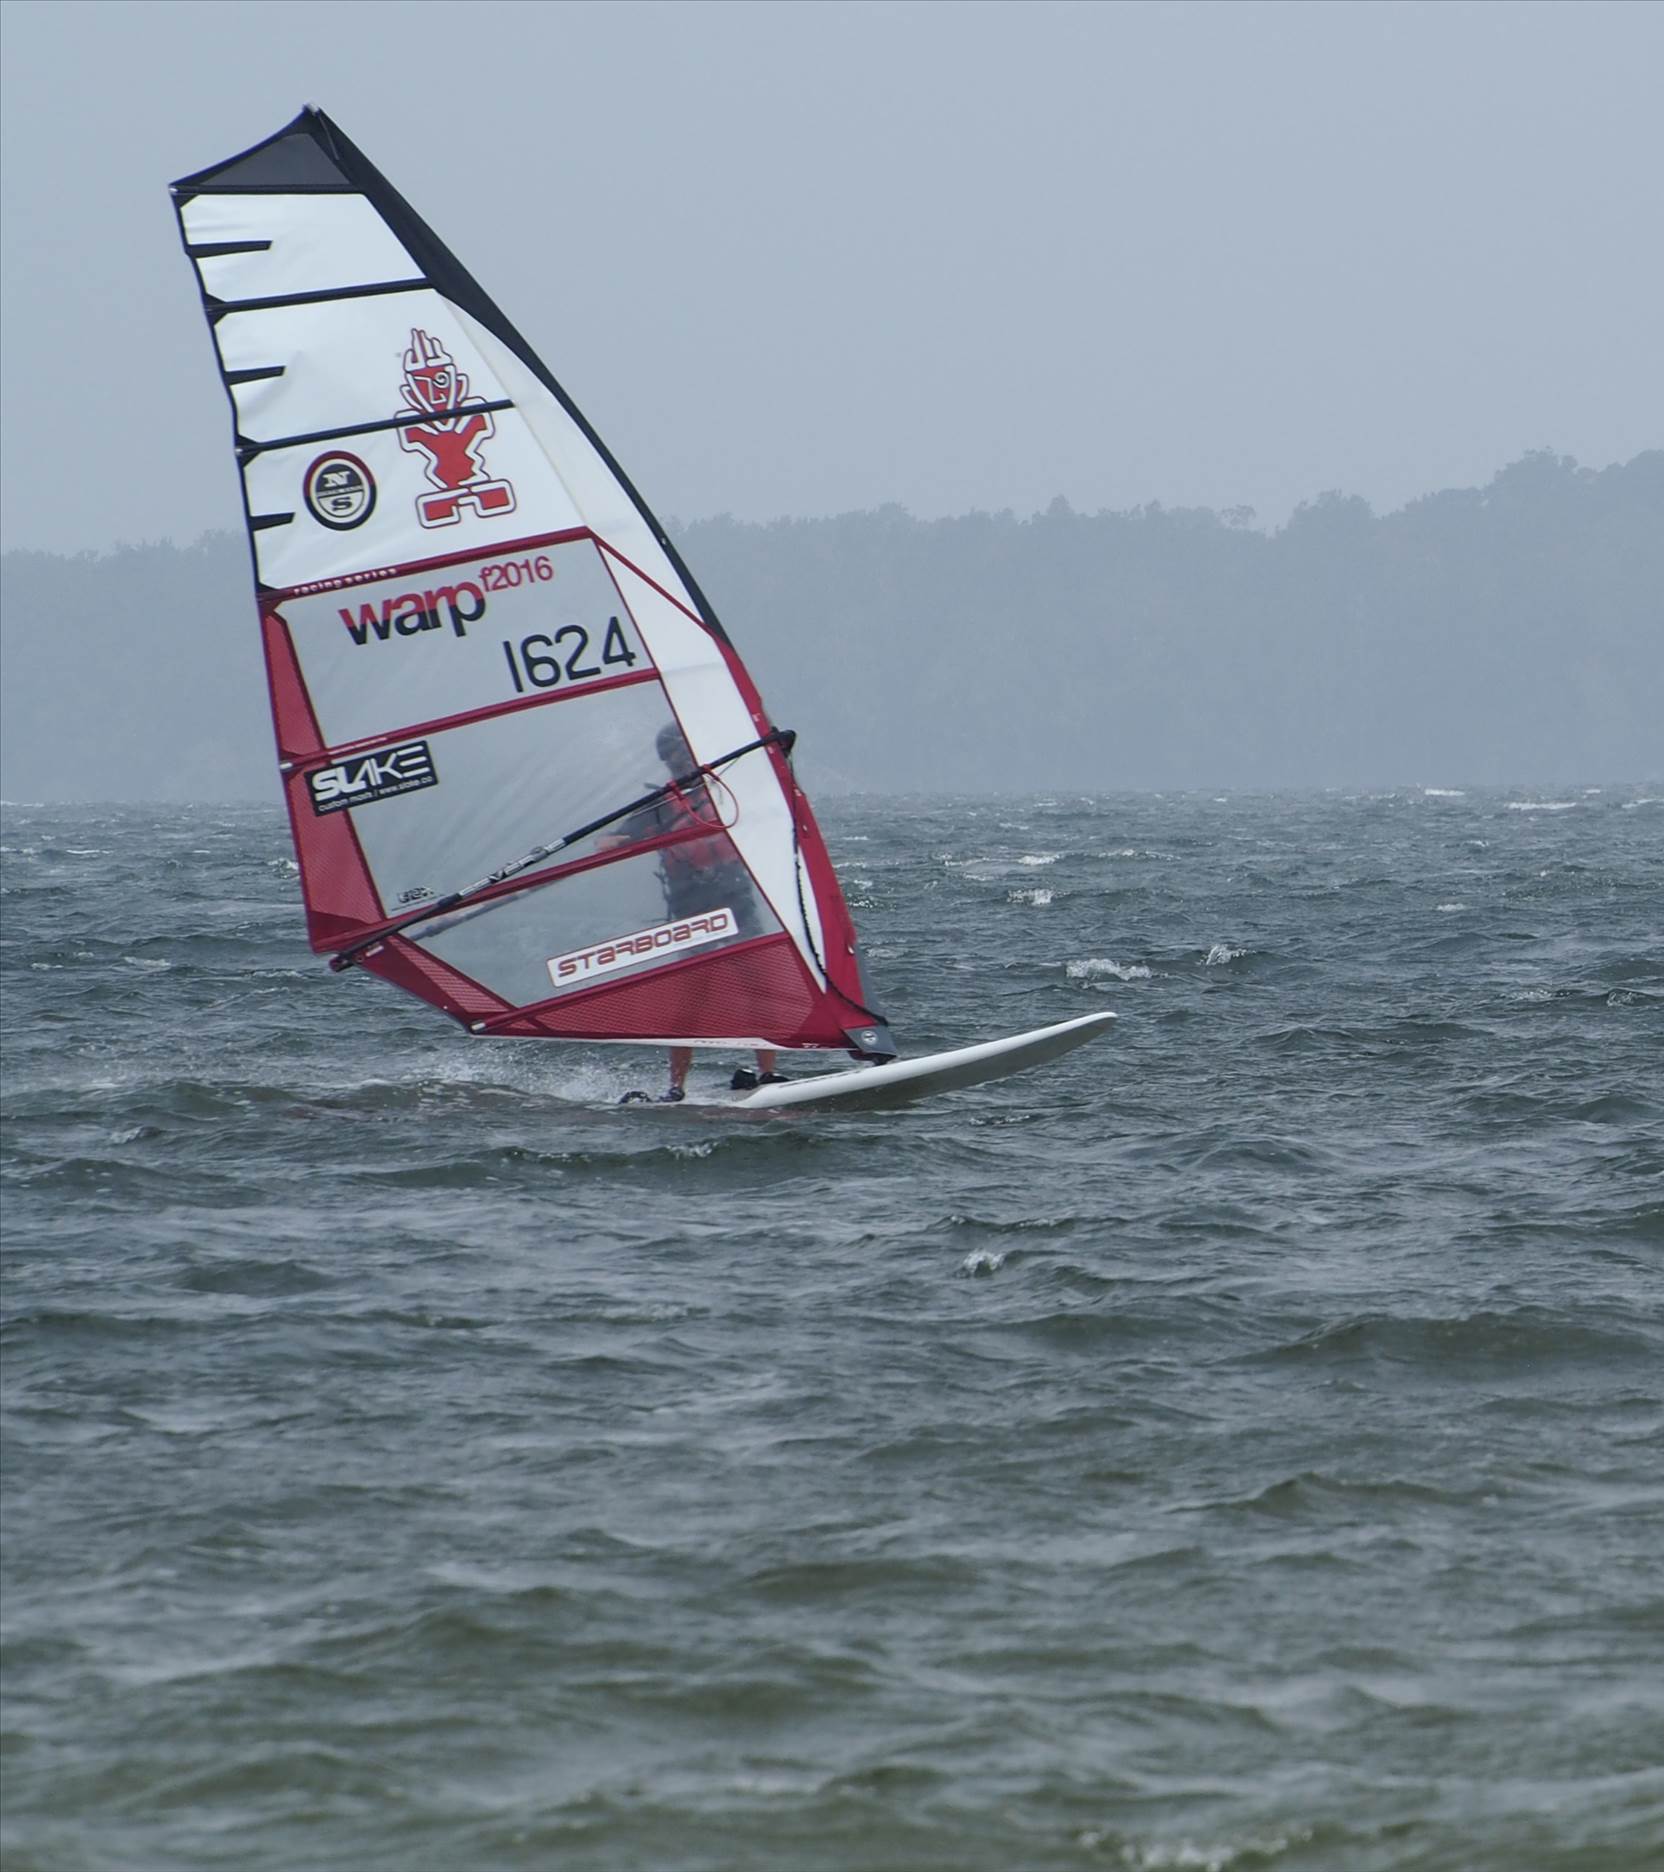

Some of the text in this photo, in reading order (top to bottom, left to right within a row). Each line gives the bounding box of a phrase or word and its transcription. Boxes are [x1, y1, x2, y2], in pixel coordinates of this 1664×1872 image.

[321, 470, 351, 488] N
[331, 496, 353, 512] S
[338, 580, 486, 646] warp
[502, 615, 637, 693] 1624
[311, 744, 431, 802] SLAKE
